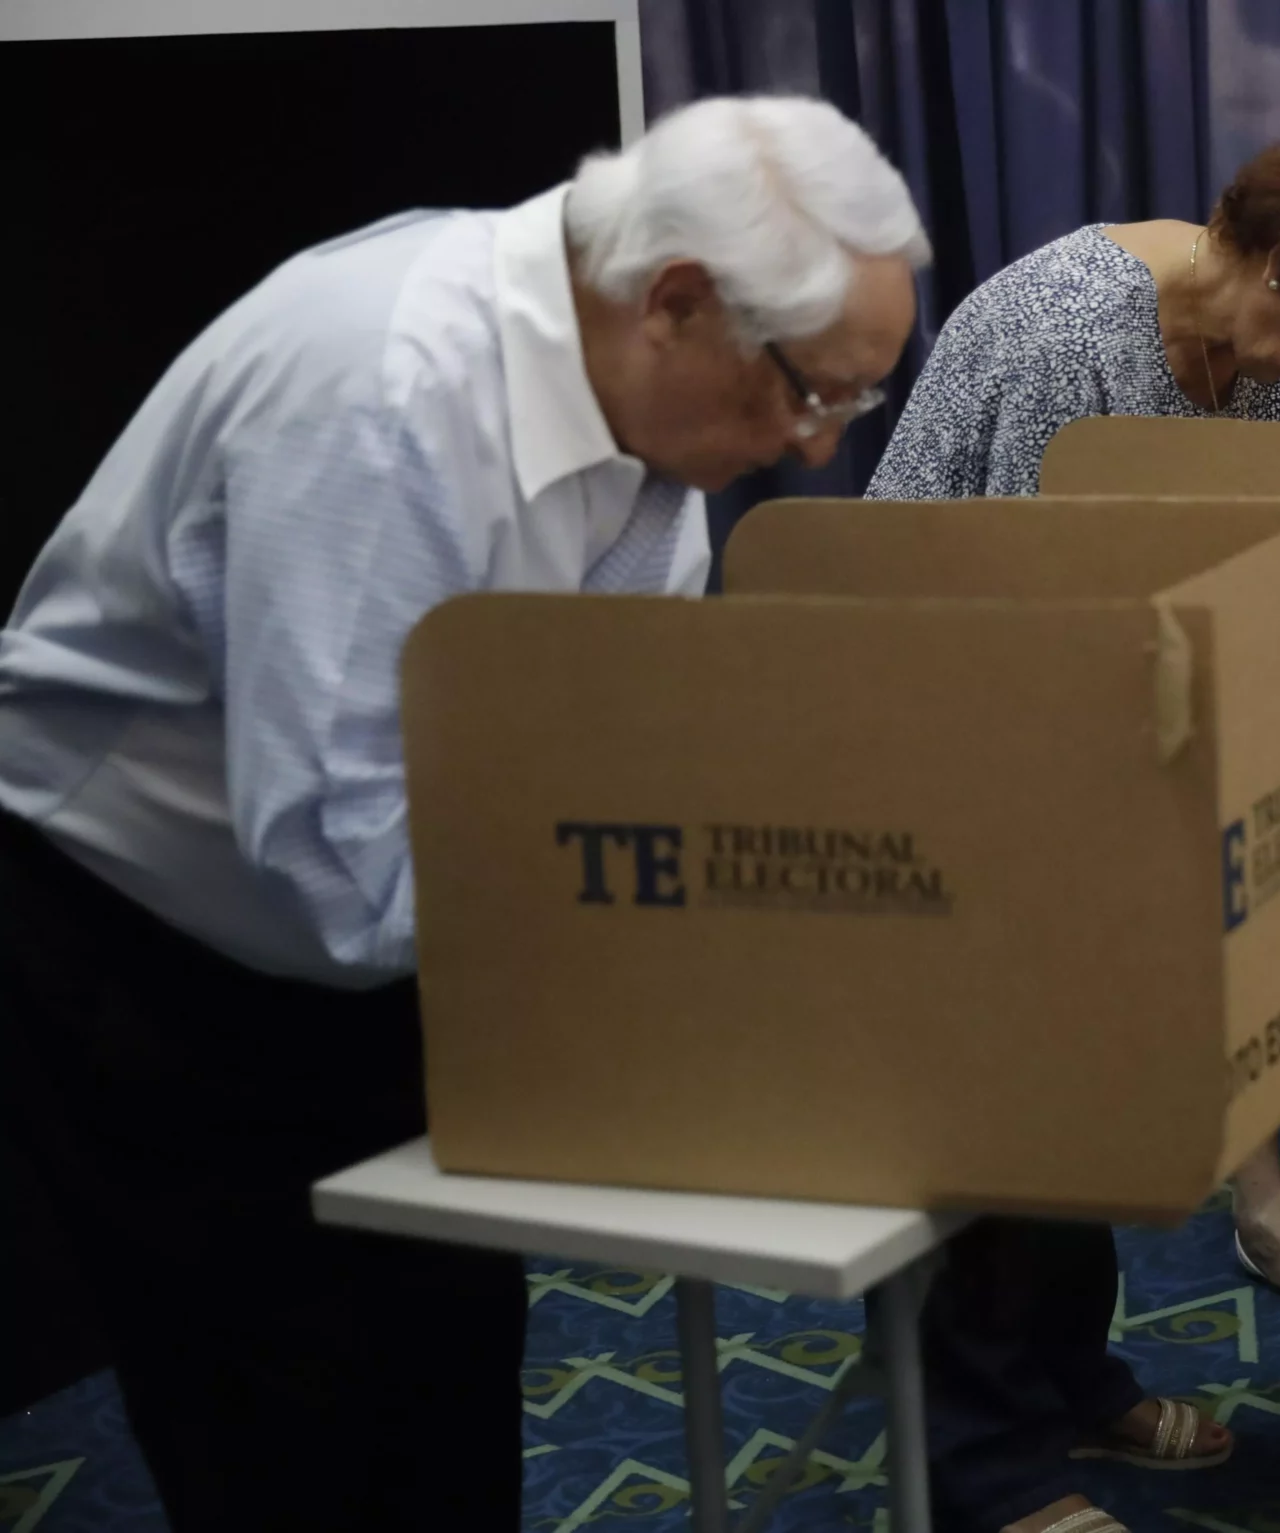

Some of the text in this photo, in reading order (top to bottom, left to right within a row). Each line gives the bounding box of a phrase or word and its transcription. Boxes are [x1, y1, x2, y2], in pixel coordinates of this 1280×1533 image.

[556, 821, 685, 906] TE
[703, 822, 922, 863] TRIBUNAL
[1222, 819, 1248, 931] E
[703, 856, 952, 901] ELECTORAL
